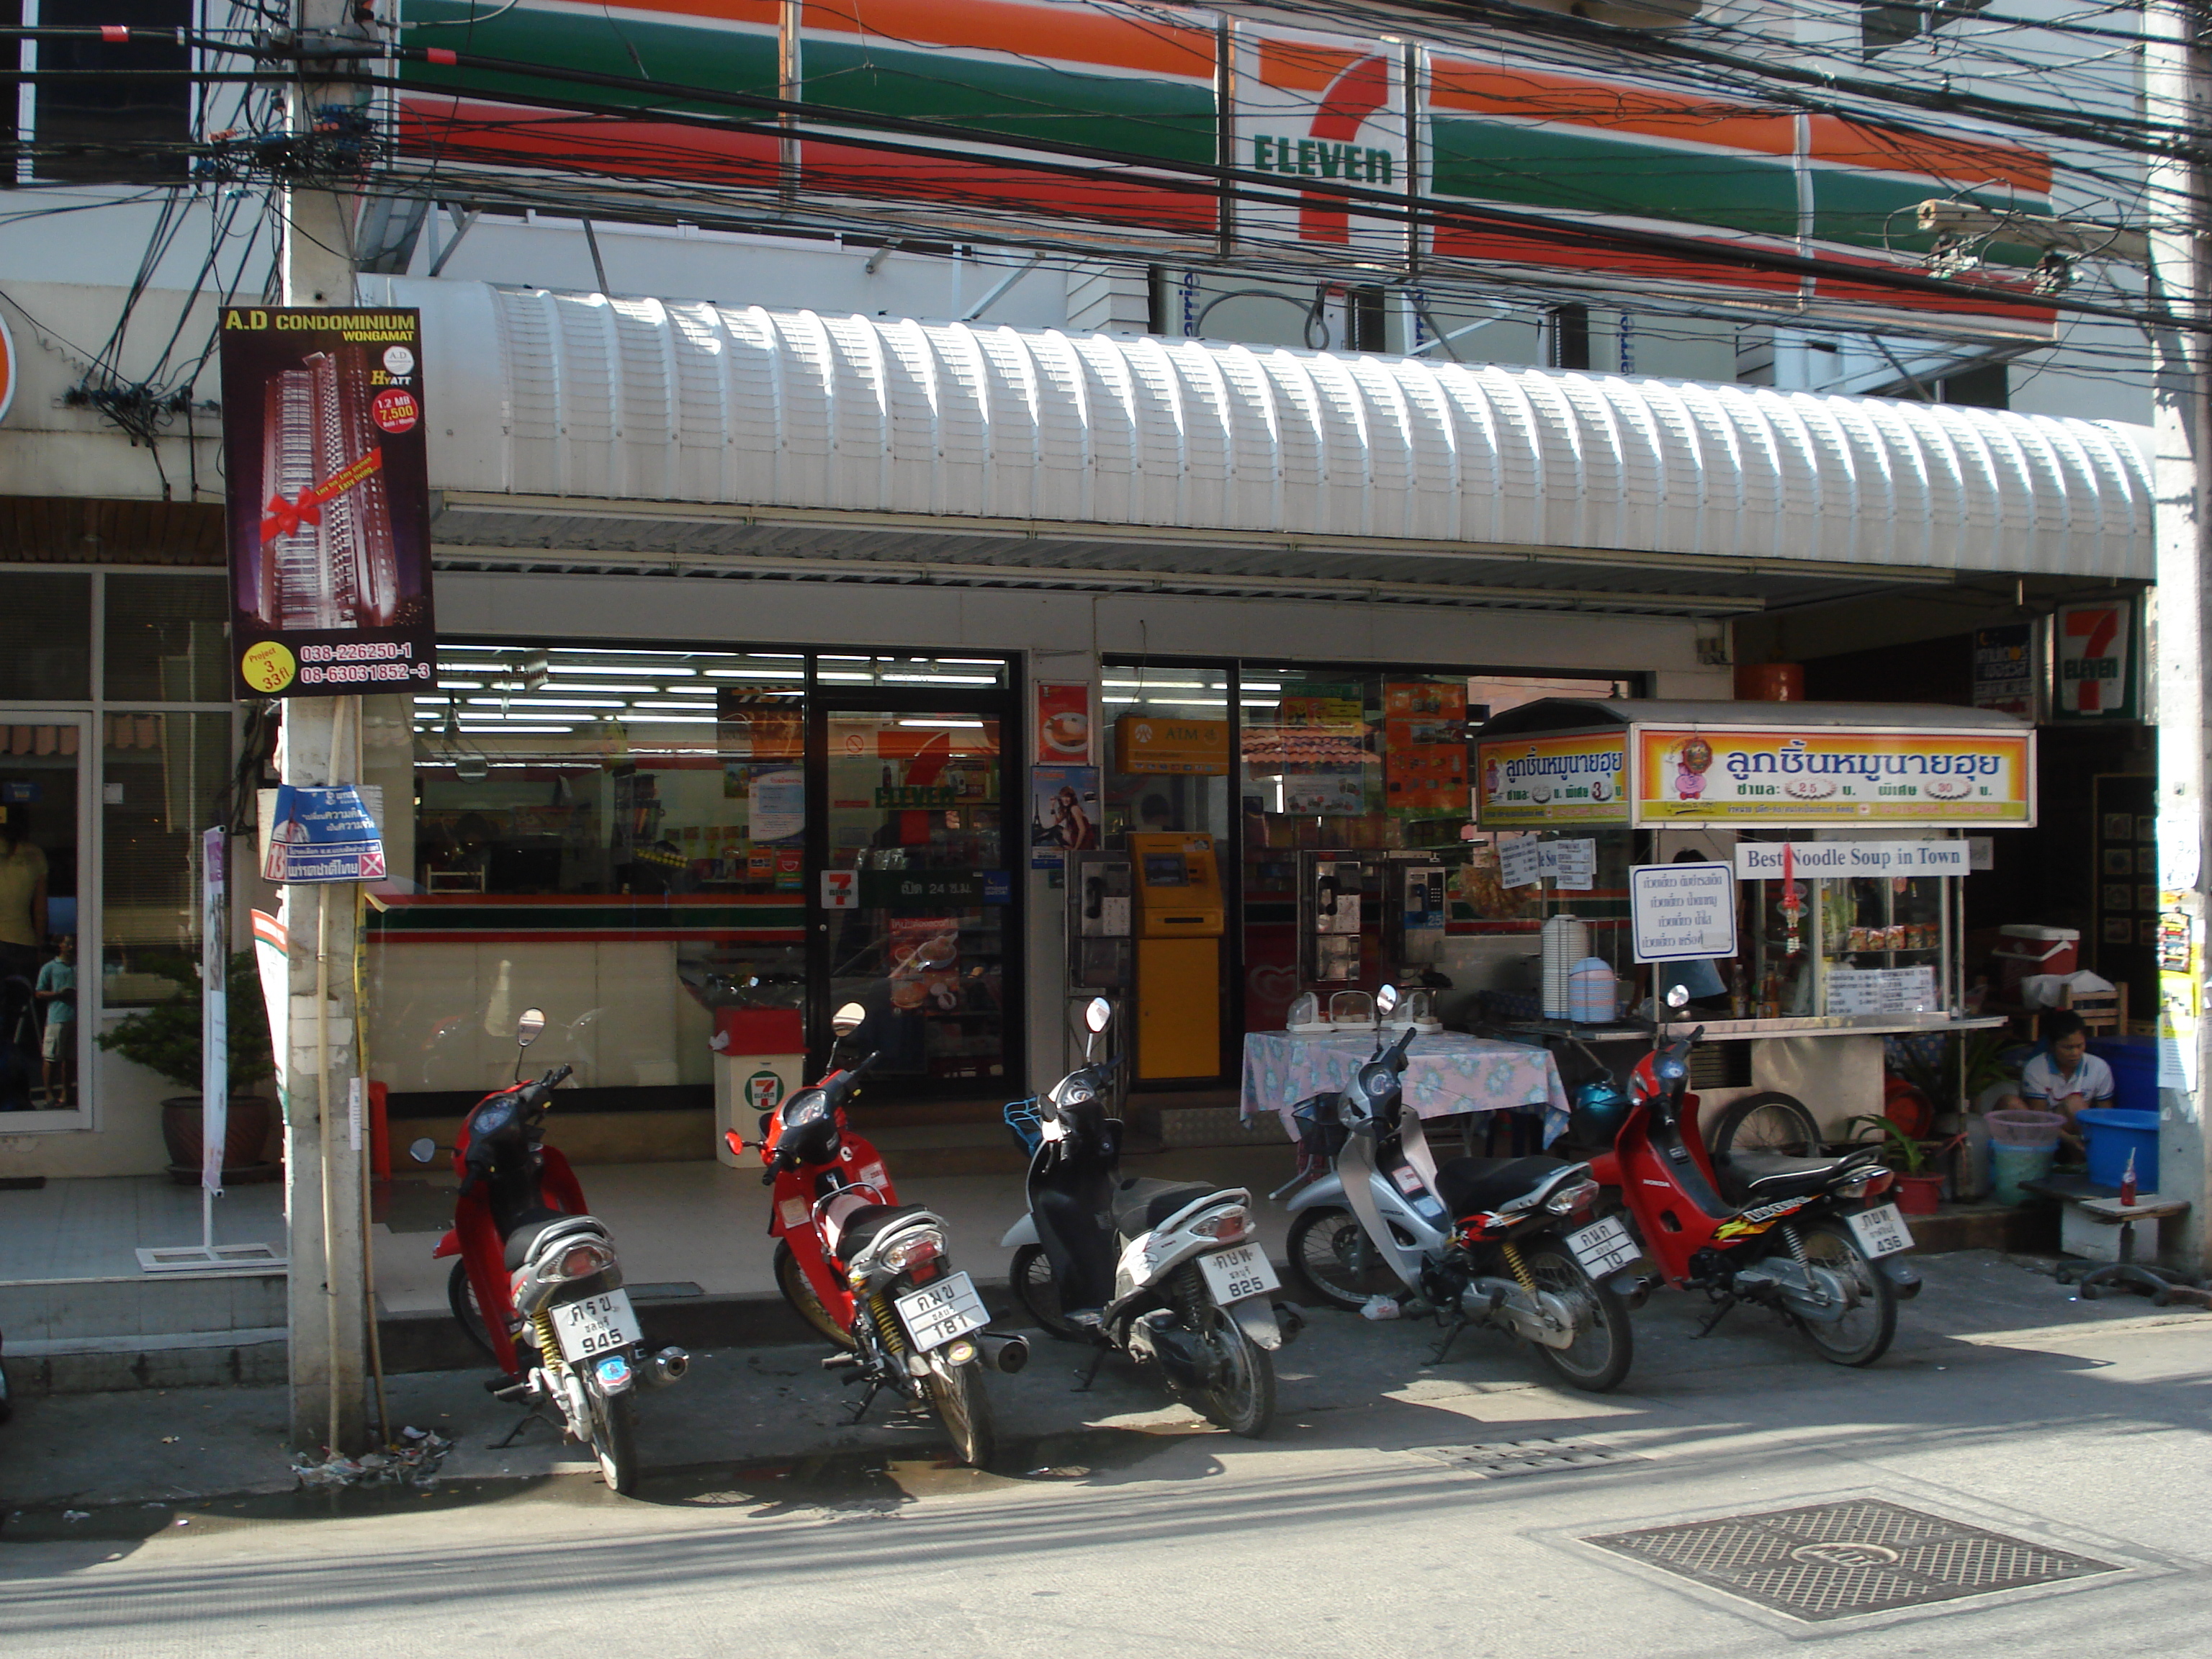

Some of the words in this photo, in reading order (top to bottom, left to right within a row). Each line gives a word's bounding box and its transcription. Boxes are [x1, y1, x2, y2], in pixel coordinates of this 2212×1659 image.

[1258, 37, 1389, 245] 7
[225, 310, 267, 331] A.D
[276, 315, 415, 331] CONDOMINIUM
[343, 331, 414, 342] WONGAMAT
[377, 399, 392, 409] 1.2
[394, 395, 410, 407] MB
[248, 647, 276, 662] Project
[300, 642, 413, 662] 038-226250-1
[263, 660, 275, 673] 3
[300, 662, 431, 684] 08-63031852-3
[1165, 727, 1198, 740] ATM
[1726, 739, 2001, 782] ลูกชิ้นหมูนายฮุย
[1799, 782, 1817, 793] 25
[1878, 782, 1917, 796] พิเศษ
[1938, 782, 1953, 793] 30
[1748, 850, 1784, 868] Best
[1789, 848, 1846, 867] Noodle
[1851, 848, 1892, 869] Soup
[1897, 848, 1913, 865] in
[1917, 847, 1961, 865] Town
[829, 873, 852, 905] 7
[929, 883, 945, 894] 24
[755, 1079, 775, 1107] 7
[1603, 1252, 1623, 1269] 10
[1228, 1276, 1264, 1297] 825
[932, 1314, 968, 1339] 181
[581, 1328, 622, 1354] 945
